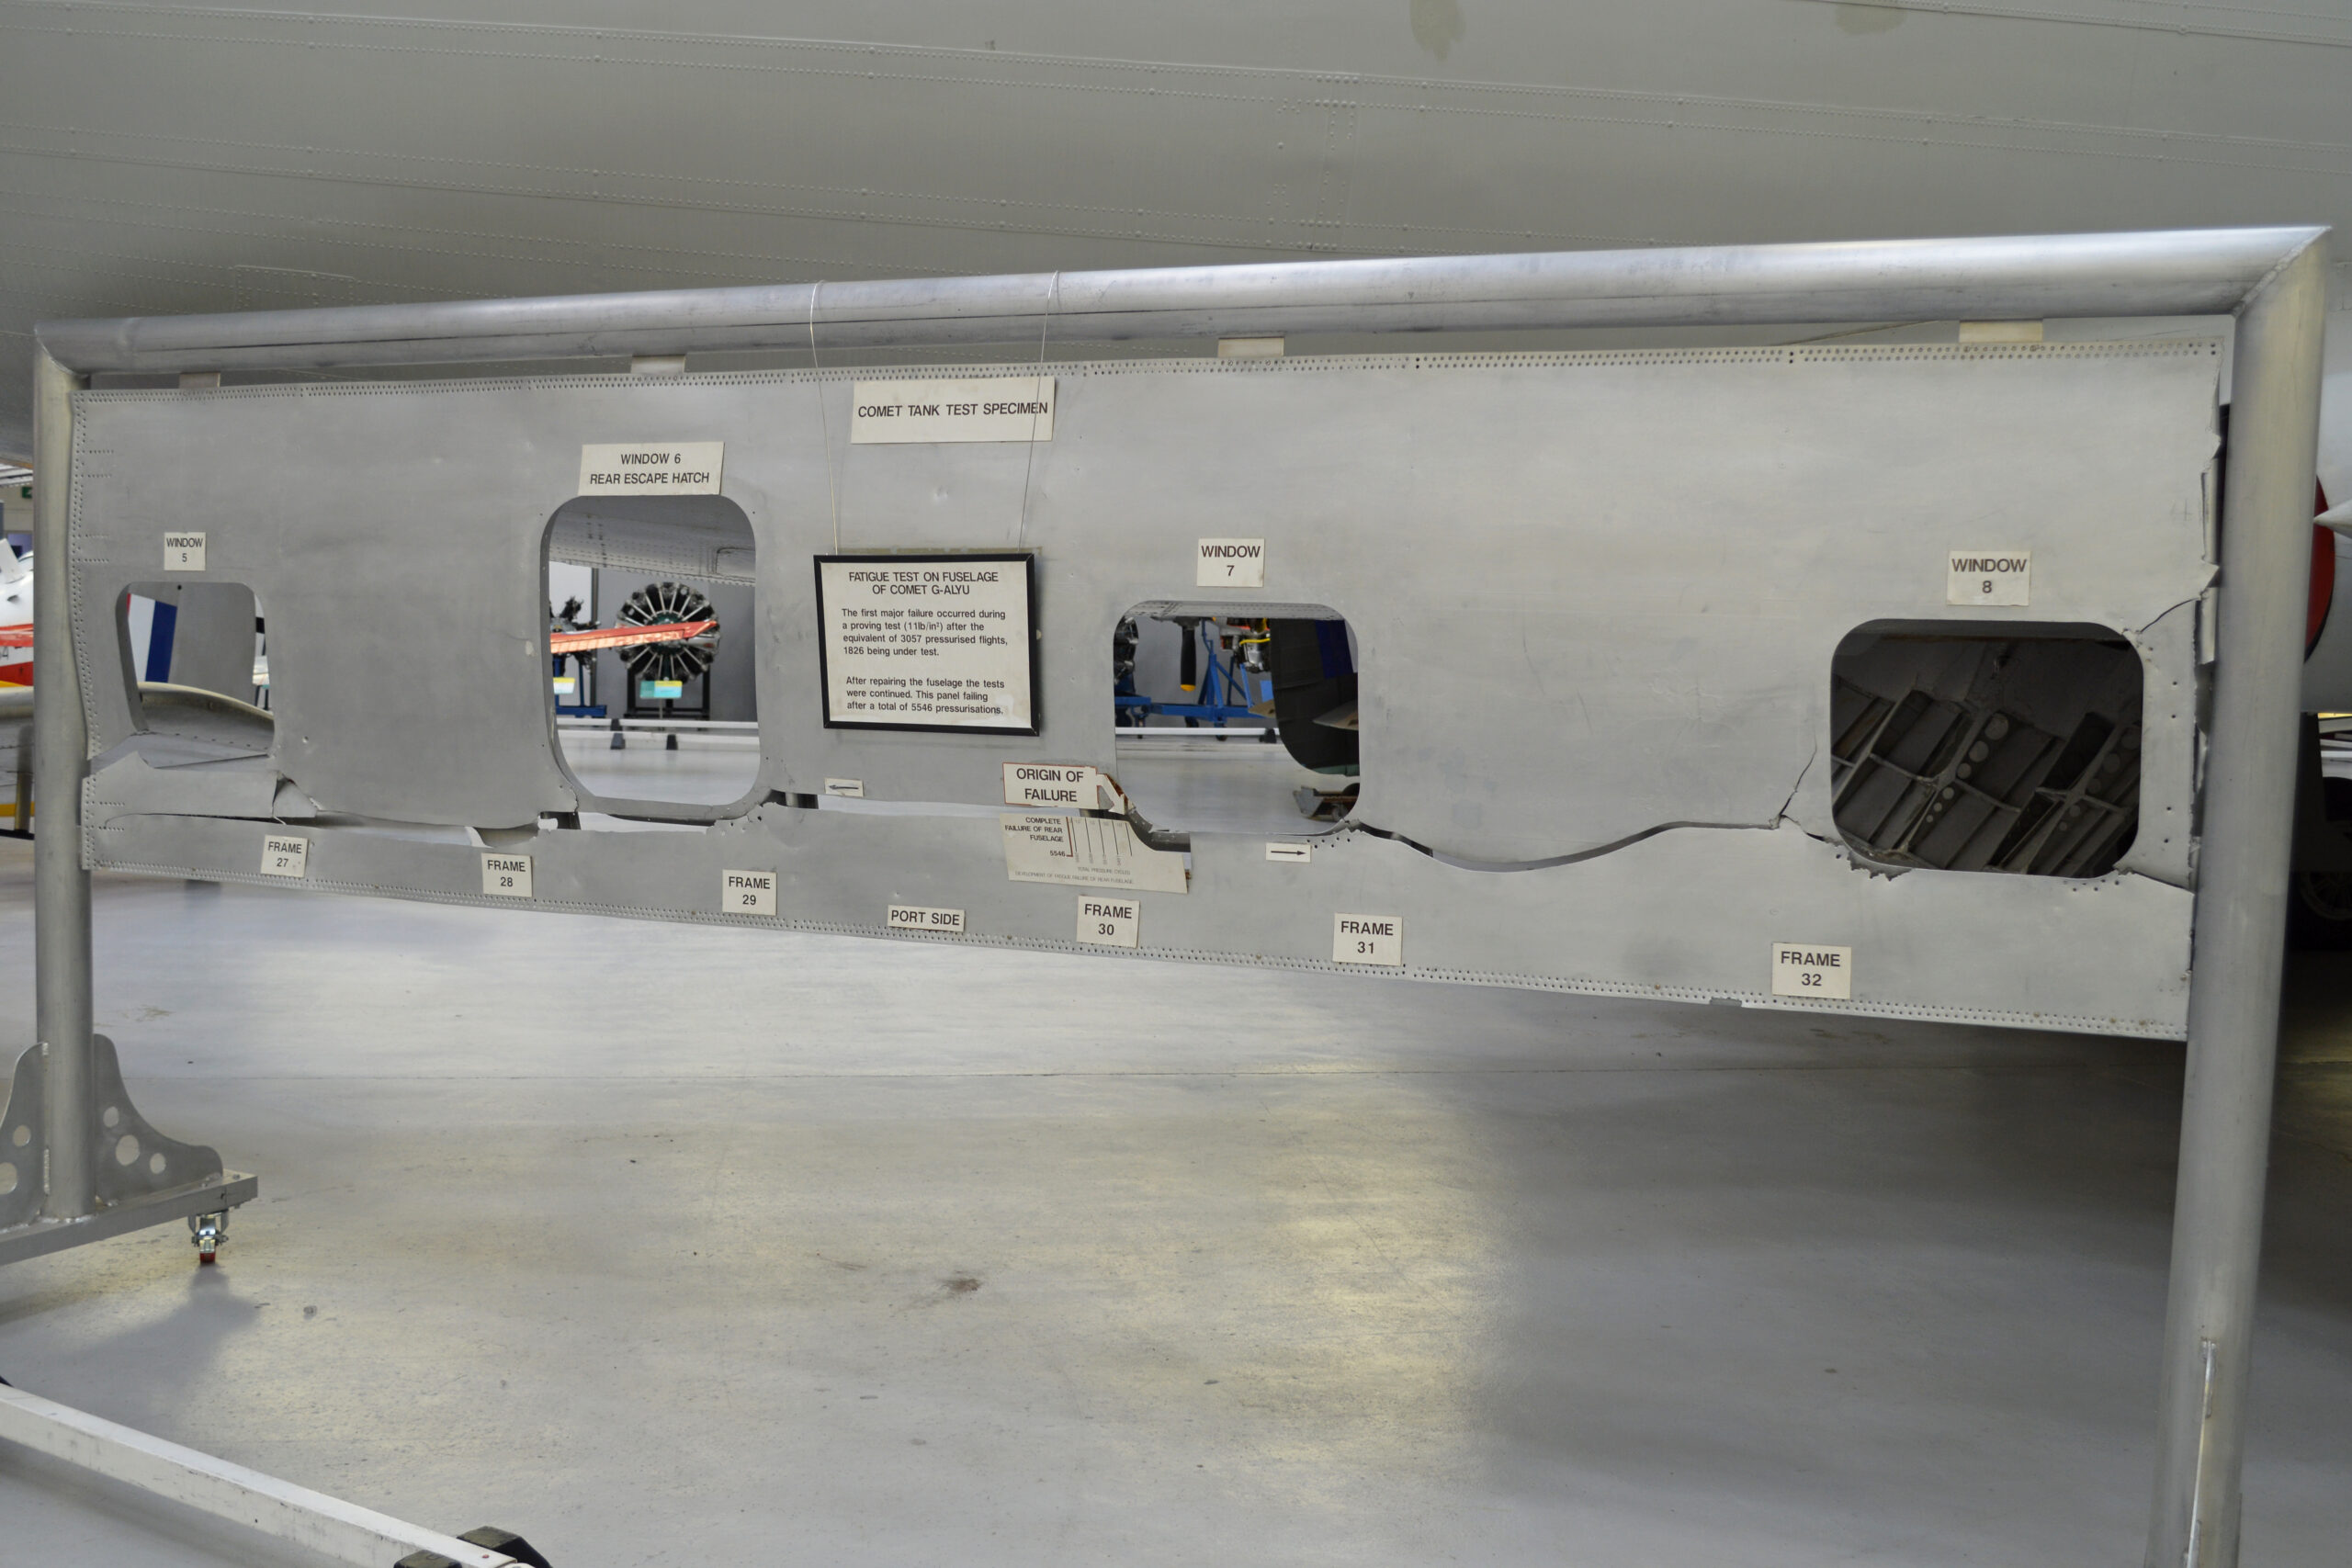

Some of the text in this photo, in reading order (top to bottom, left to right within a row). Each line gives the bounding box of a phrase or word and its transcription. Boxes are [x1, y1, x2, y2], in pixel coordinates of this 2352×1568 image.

[858, 402, 1048, 418] COMET TANK TEST SPECIMEN
[620, 453, 682, 465] WINDOW 6
[590, 472, 709, 485] REAR ESCAPE HATCH
[166, 537, 203, 548] WINDOW
[182, 553, 187, 563] 5
[1201, 545, 1261, 558] WINDOW
[1227, 564, 1236, 577] 7
[1951, 558, 2028, 573] WINDOW
[849, 571, 999, 582] FATIGUE TEST ON FUSELAGE
[872, 584, 970, 595] OF COMET G-ALYU
[1982, 580, 1993, 594] 8
[842, 608, 1006, 621] The first major failure occurred during
[850, 622, 882, 632] proving
[885, 622, 901, 631] test
[946, 622, 967, 631] after
[970, 623, 985, 631] the
[842, 634, 1008, 647] equivalent of 3057 pressurised flights,
[843, 646, 940, 658] 1826 being under test.
[846, 676, 1005, 689] After repairing the fuselage the tests
[869, 690, 913, 699] continued.
[916, 690, 934, 699] This
[937, 691, 960, 702] panel
[963, 692, 989, 703] failing
[846, 701, 866, 710] after
[877, 702, 897, 711] total
[899, 703, 908, 711] of
[910, 703, 933, 712] 5546
[935, 704, 1004, 715] pressurisations.
[1016, 768, 1084, 783] ORIGIN OF
[1024, 788, 1078, 802] FAILURE
[1025, 817, 1062, 825] COMPLETE
[1029, 834, 1064, 842] FUSELAGE
[267, 841, 302, 854] FRAME
[277, 857, 289, 867] 27
[487, 859, 526, 873] FRAME
[500, 876, 514, 887] 28
[729, 876, 771, 890] FRAME
[742, 895, 757, 906] 29
[891, 909, 960, 926] PORT SIDE
[1084, 903, 1133, 919] FRAME
[1098, 923, 1114, 936] 30
[1340, 920, 1394, 936] FRAME
[1357, 941, 1374, 954] 31
[1781, 951, 1841, 967] FRAME
[1801, 973, 1822, 987] 32
